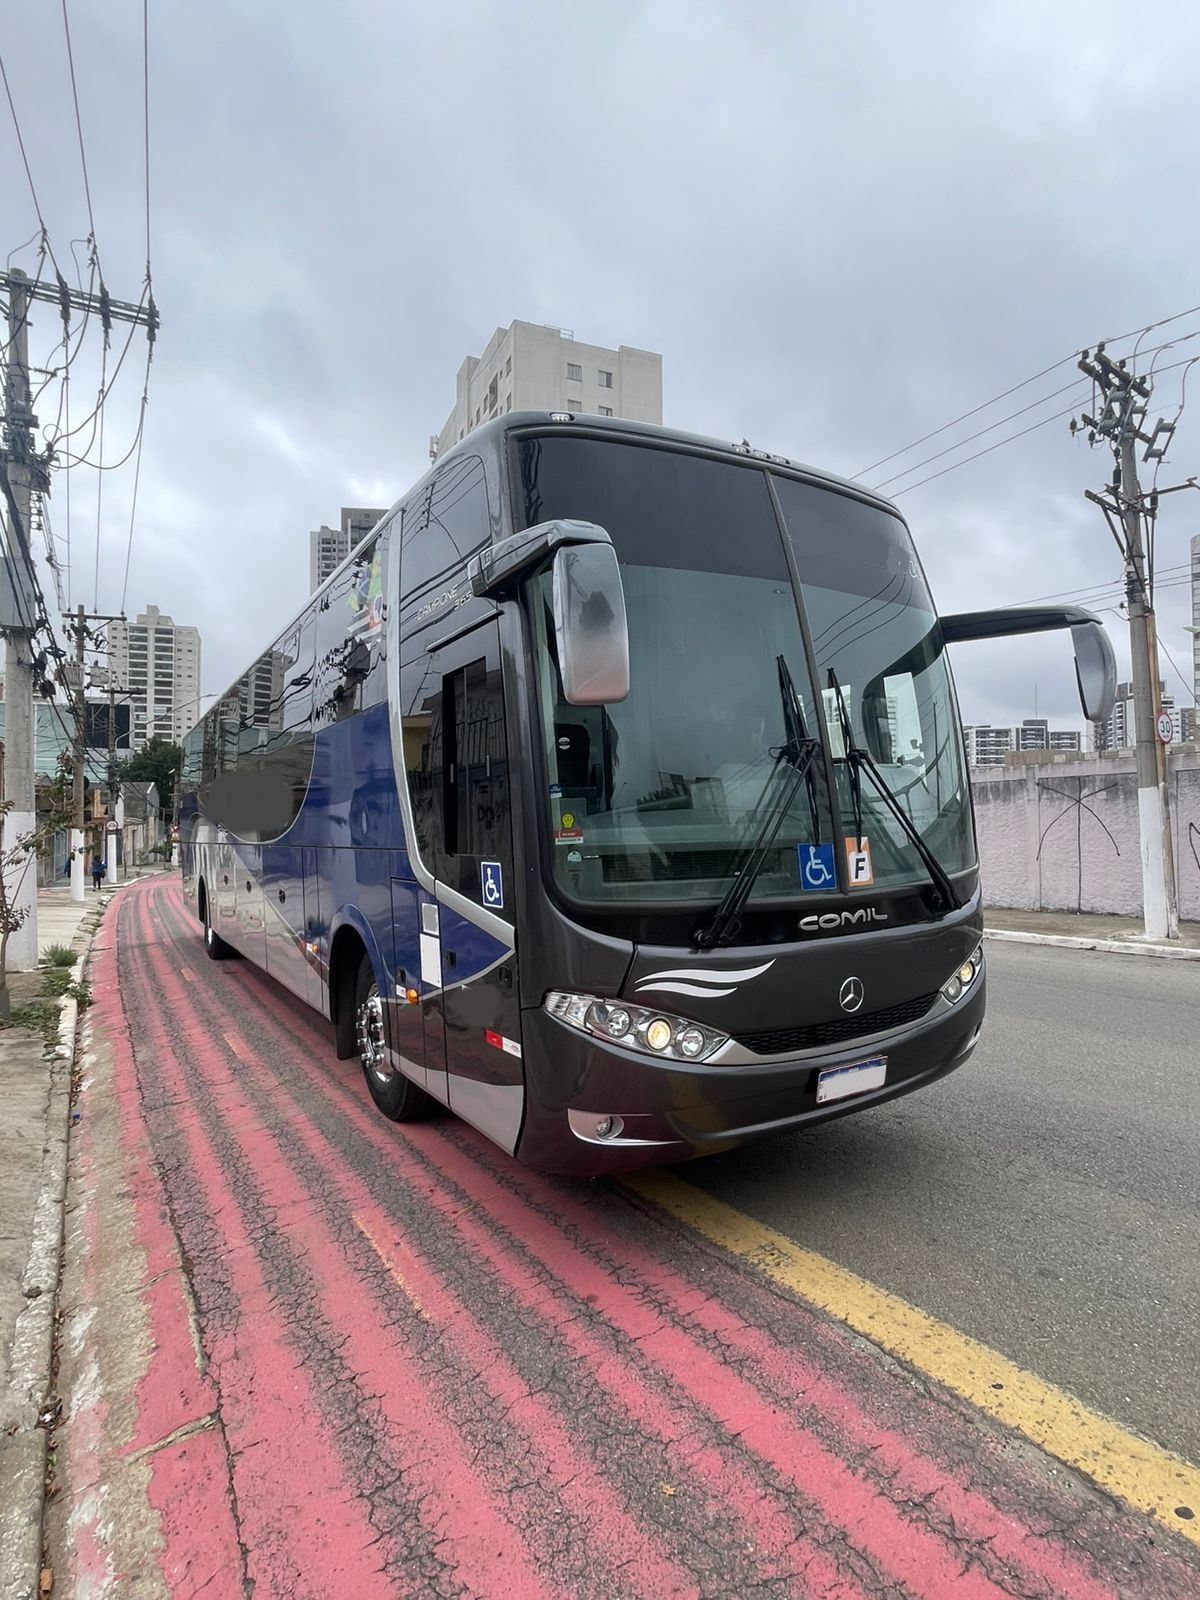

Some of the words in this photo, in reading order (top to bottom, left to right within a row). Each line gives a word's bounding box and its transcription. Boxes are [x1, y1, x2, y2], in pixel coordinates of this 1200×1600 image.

[1160, 720, 1171, 734] 30
[855, 858, 866, 880] F
[798, 907, 888, 931] COMIL
